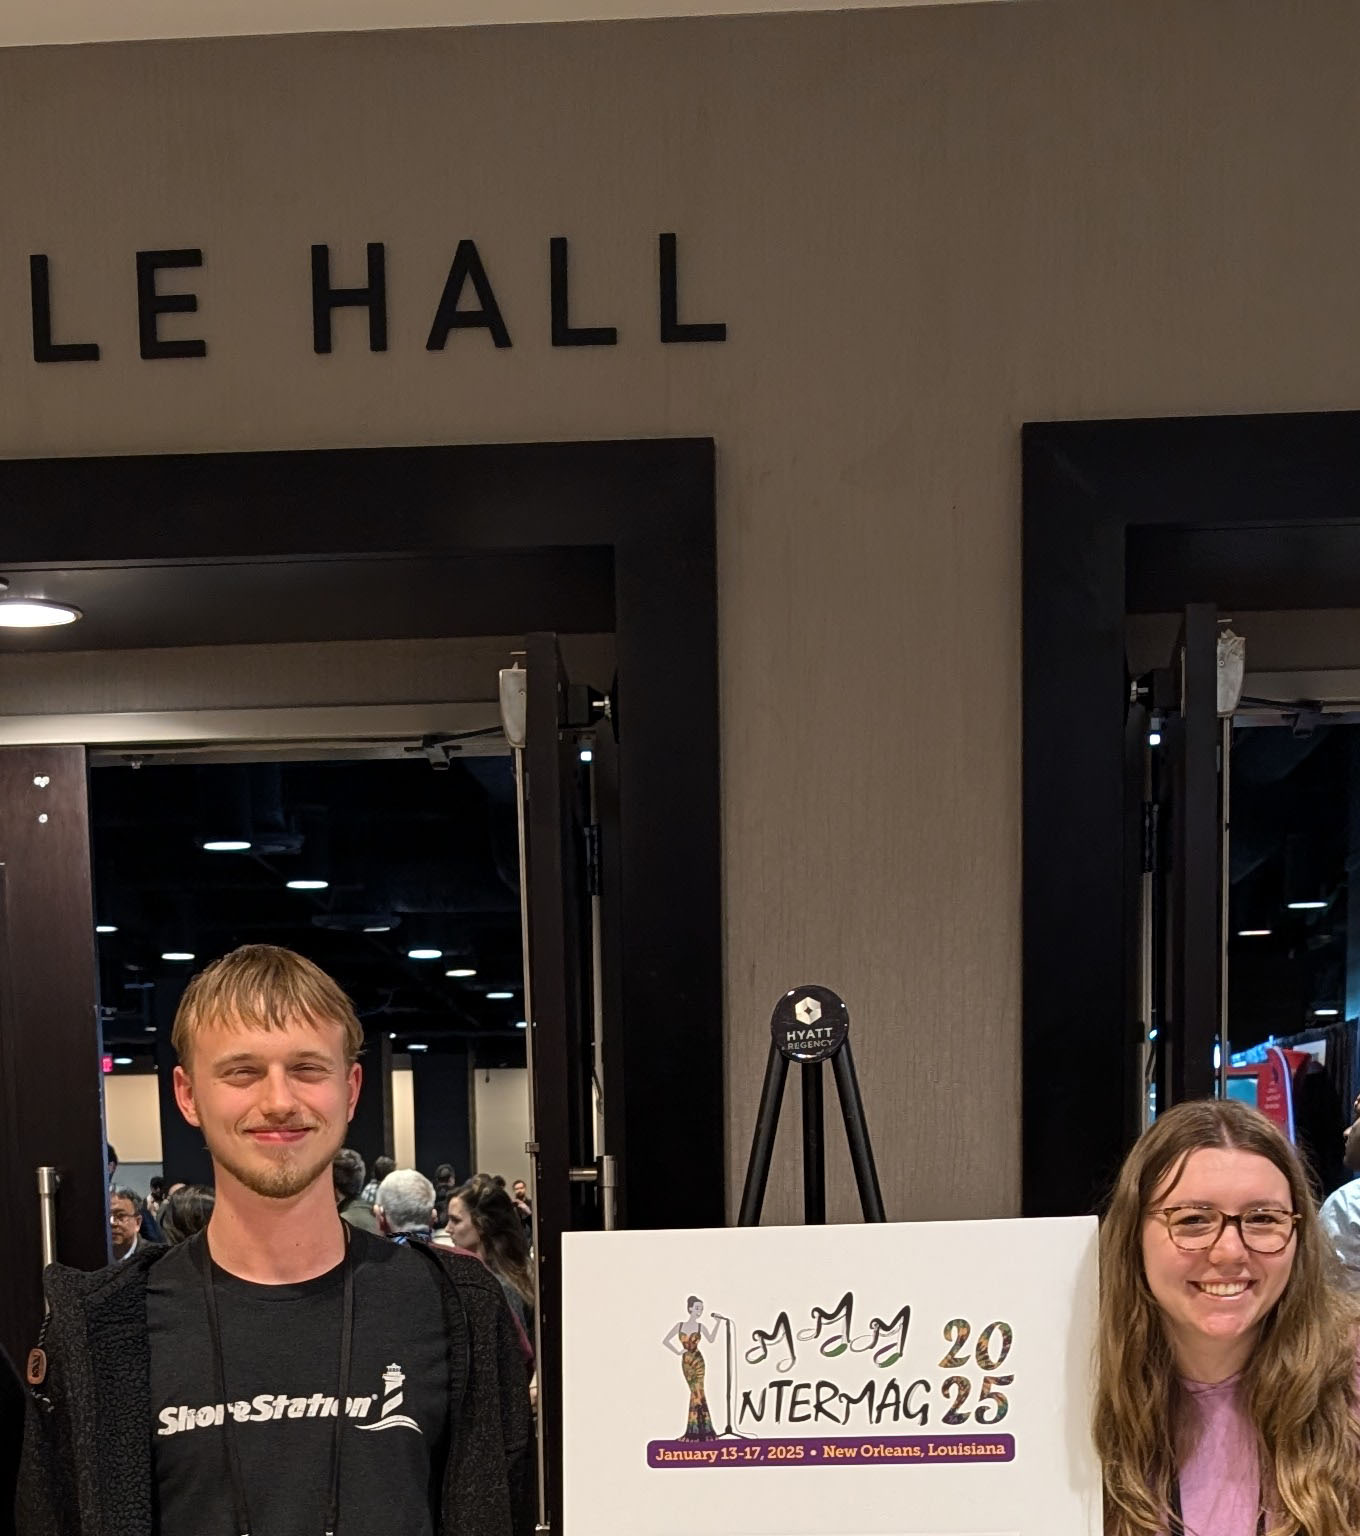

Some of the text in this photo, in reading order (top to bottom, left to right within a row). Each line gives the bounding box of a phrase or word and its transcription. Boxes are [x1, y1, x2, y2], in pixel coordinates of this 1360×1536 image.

[309, 232, 728, 355] HALL
[786, 1027, 833, 1041] HYATT
[787, 1040, 833, 1050] REGENCY
[938, 1318, 1014, 1371] 20
[941, 1374, 1015, 1425] 25
[656, 1442, 1006, 1463] January 13-17, 2025 New Orleans, Louisiana
